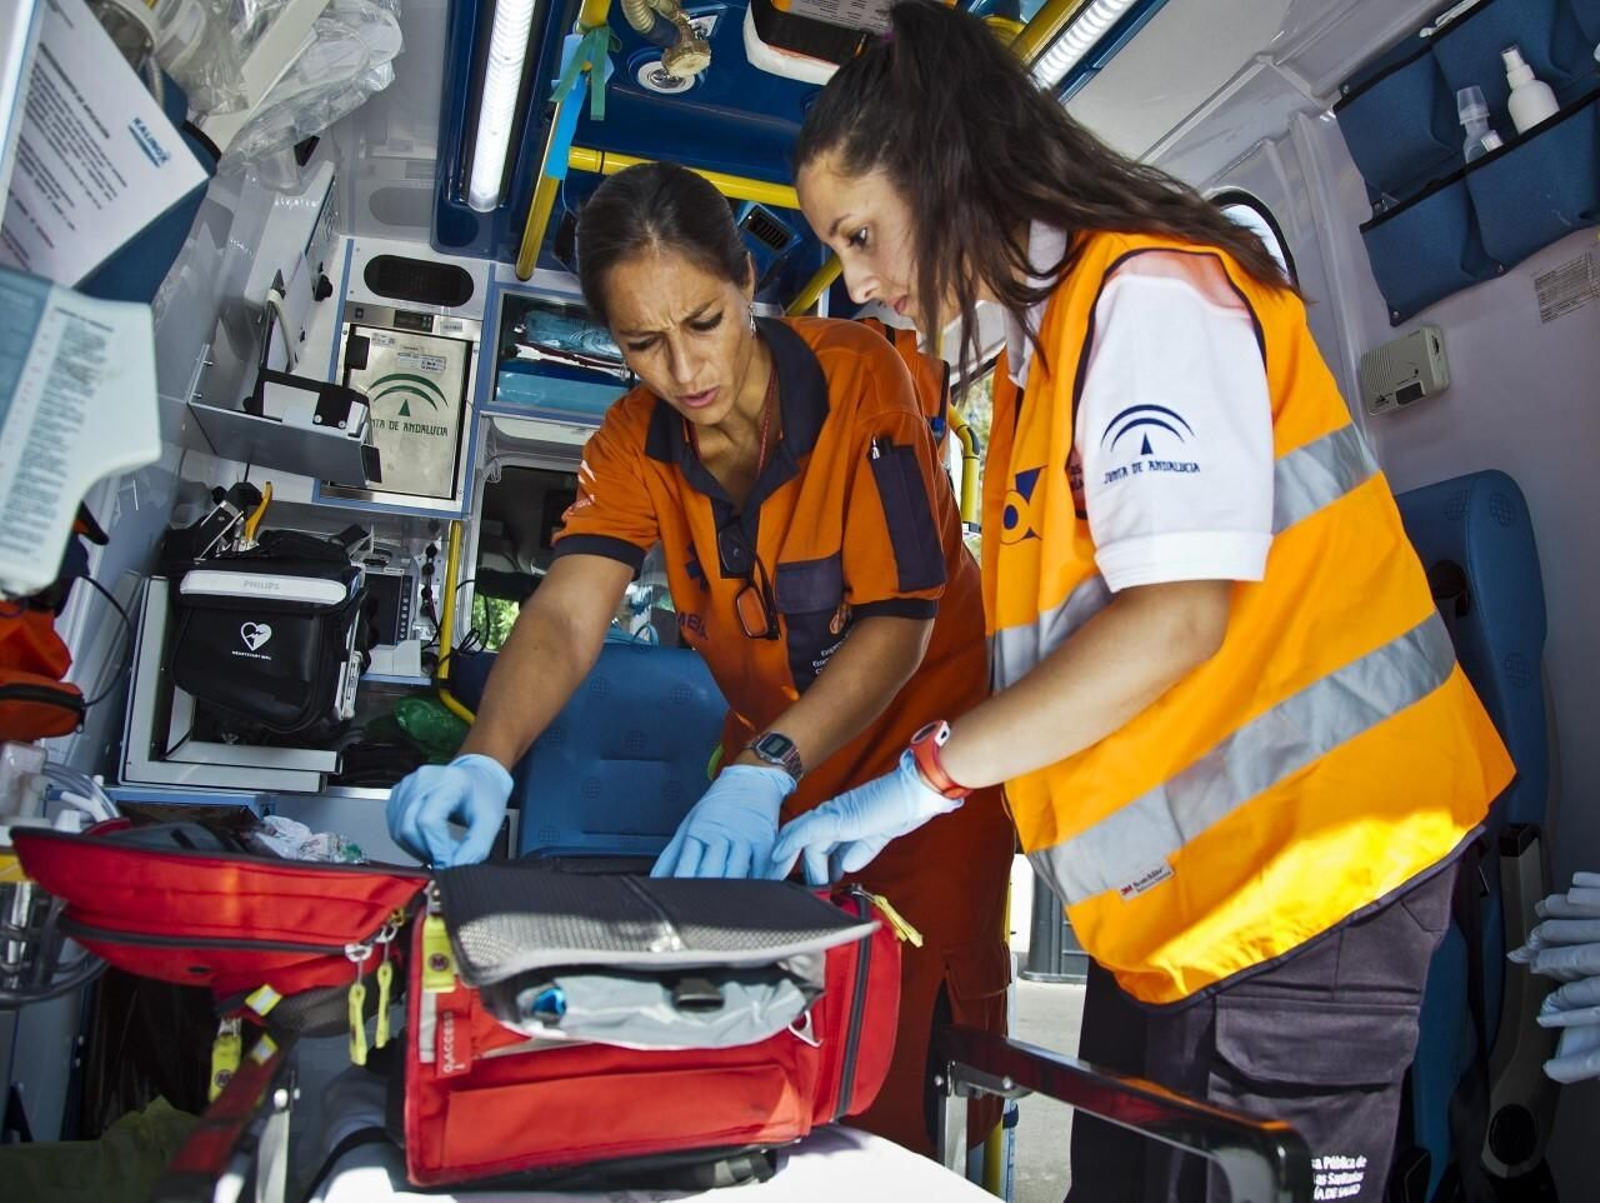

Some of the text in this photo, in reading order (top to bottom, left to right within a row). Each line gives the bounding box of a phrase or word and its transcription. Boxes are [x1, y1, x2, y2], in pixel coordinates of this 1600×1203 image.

[388, 420, 400, 431] DE
[1131, 461, 1143, 474] DE
[243, 580, 280, 590] PHILIPS
